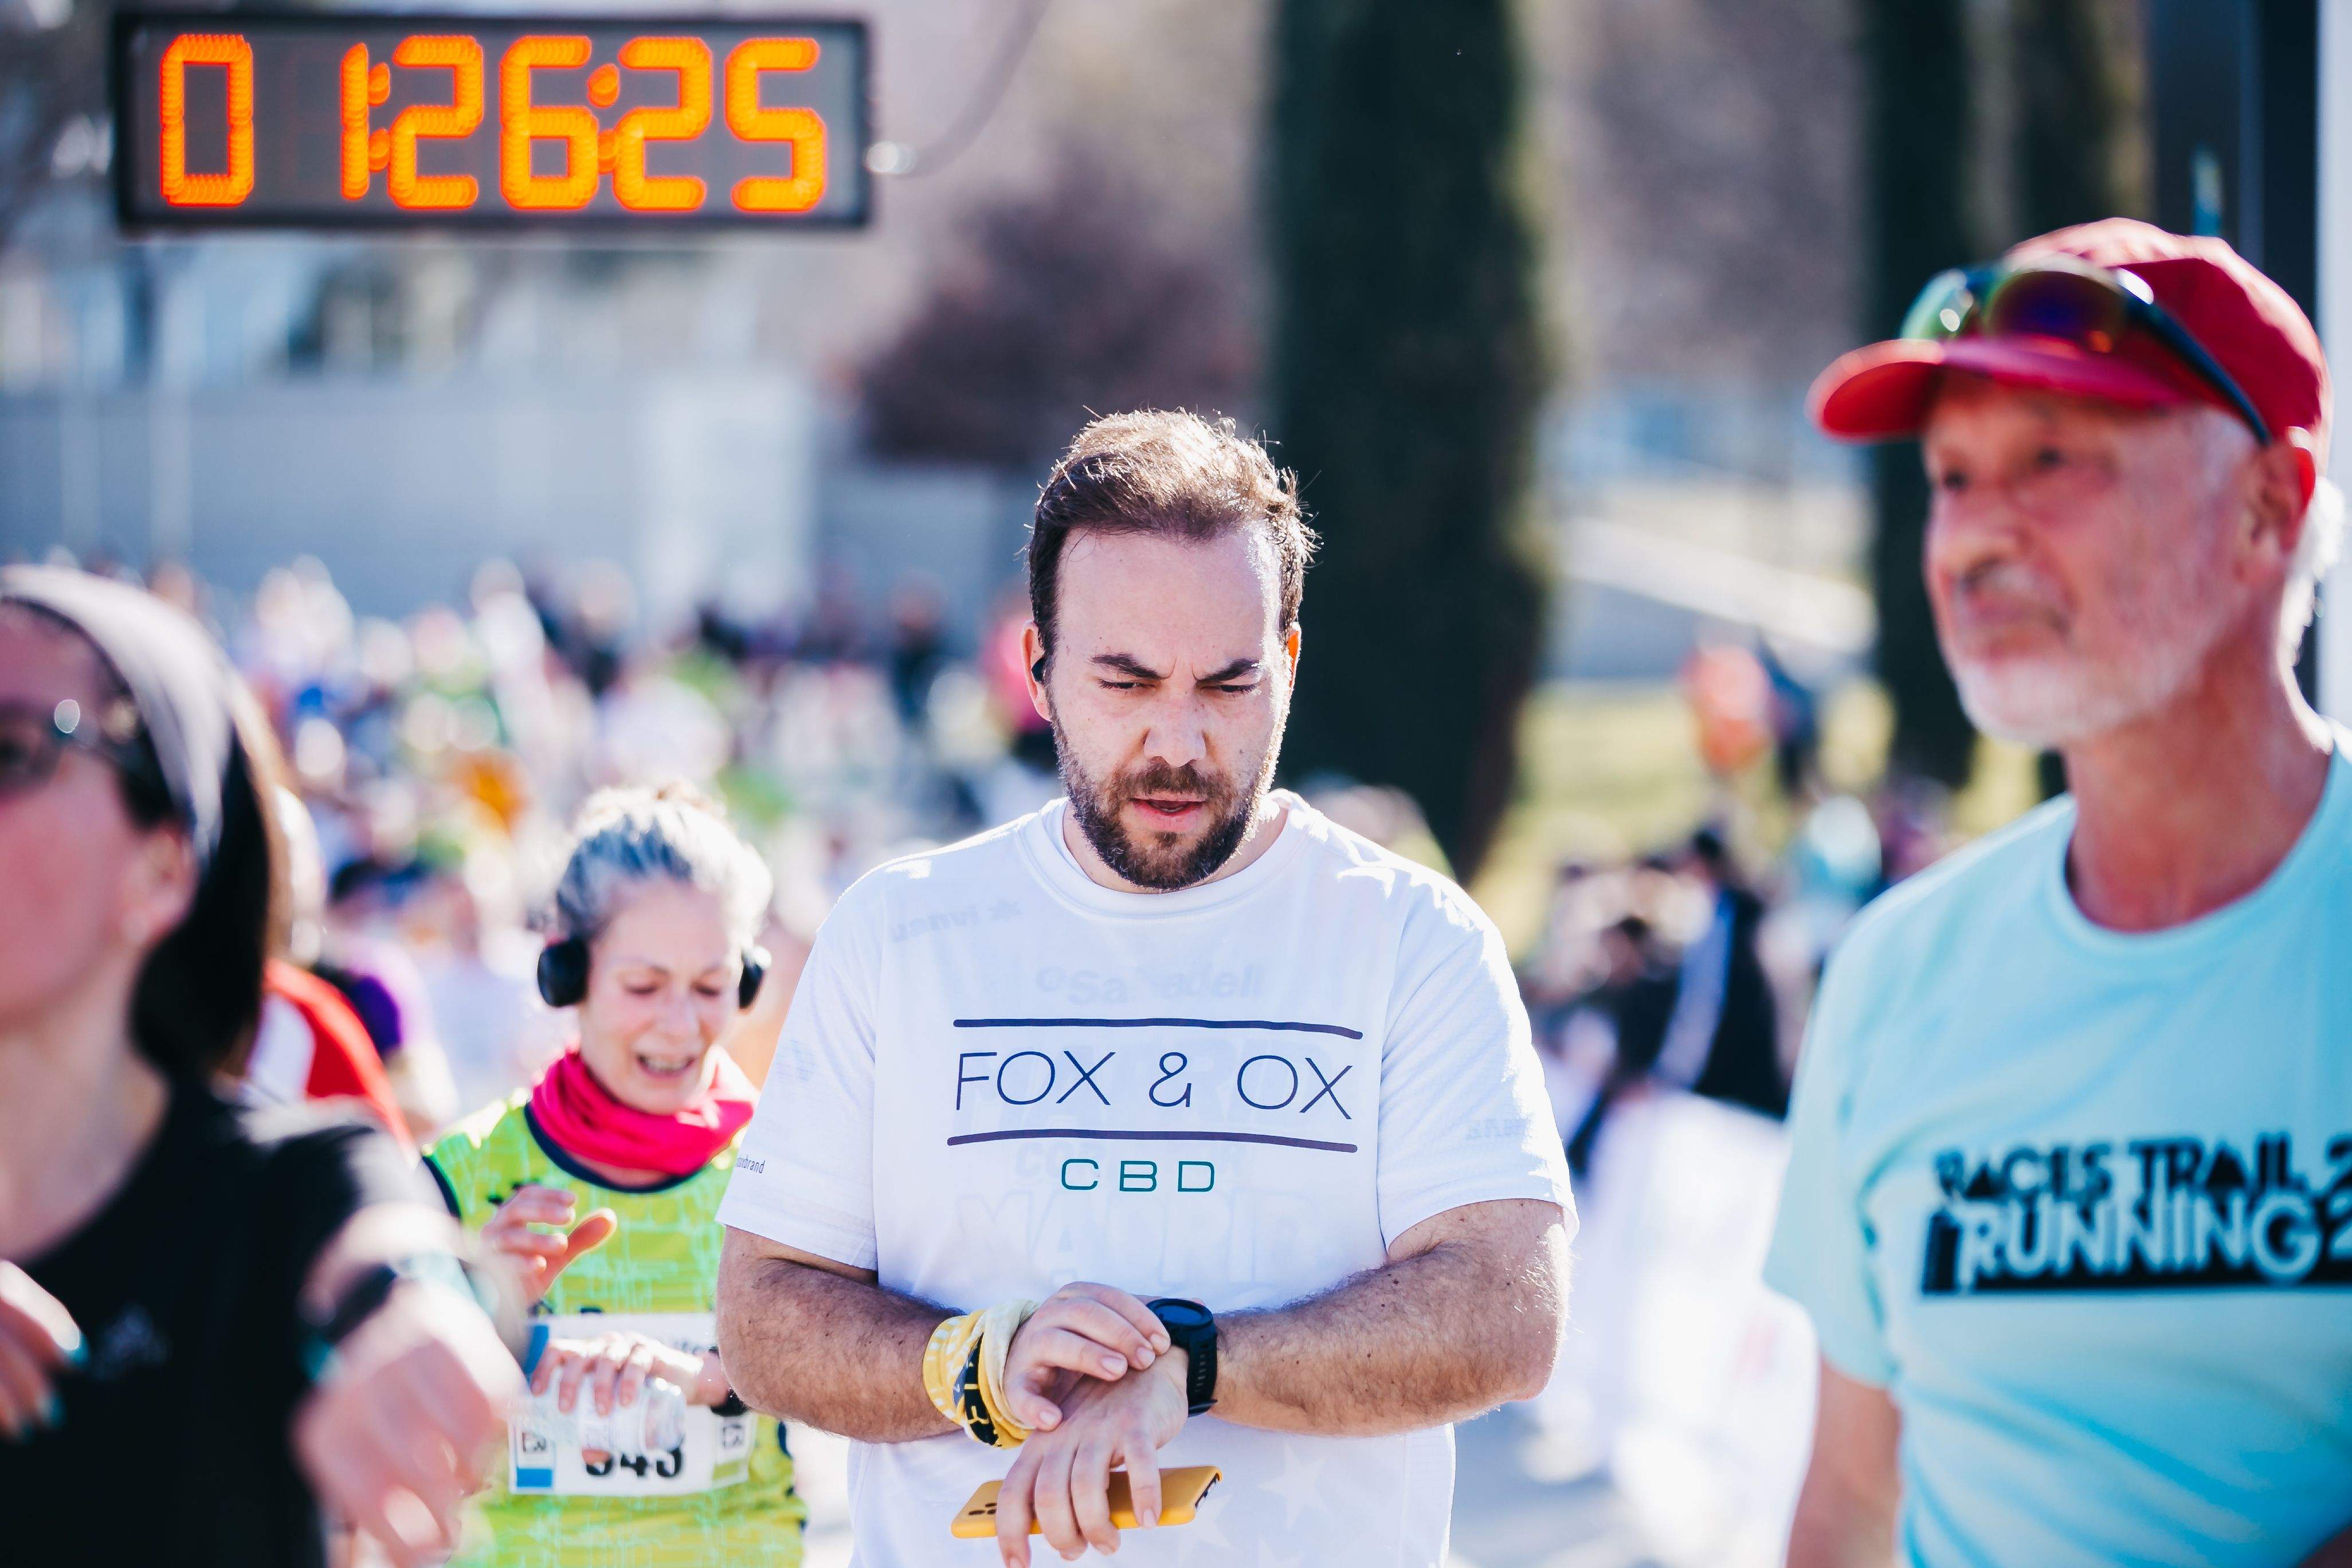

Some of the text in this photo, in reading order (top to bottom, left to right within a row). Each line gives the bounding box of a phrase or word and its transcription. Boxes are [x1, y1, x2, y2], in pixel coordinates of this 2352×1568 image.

[956, 1050, 1353, 1120] FOX & OX
[1061, 1158, 1215, 1193] CBD
[2126, 1132, 2305, 1194] TRAIL
[1952, 1191, 2319, 1287] RUNNING
